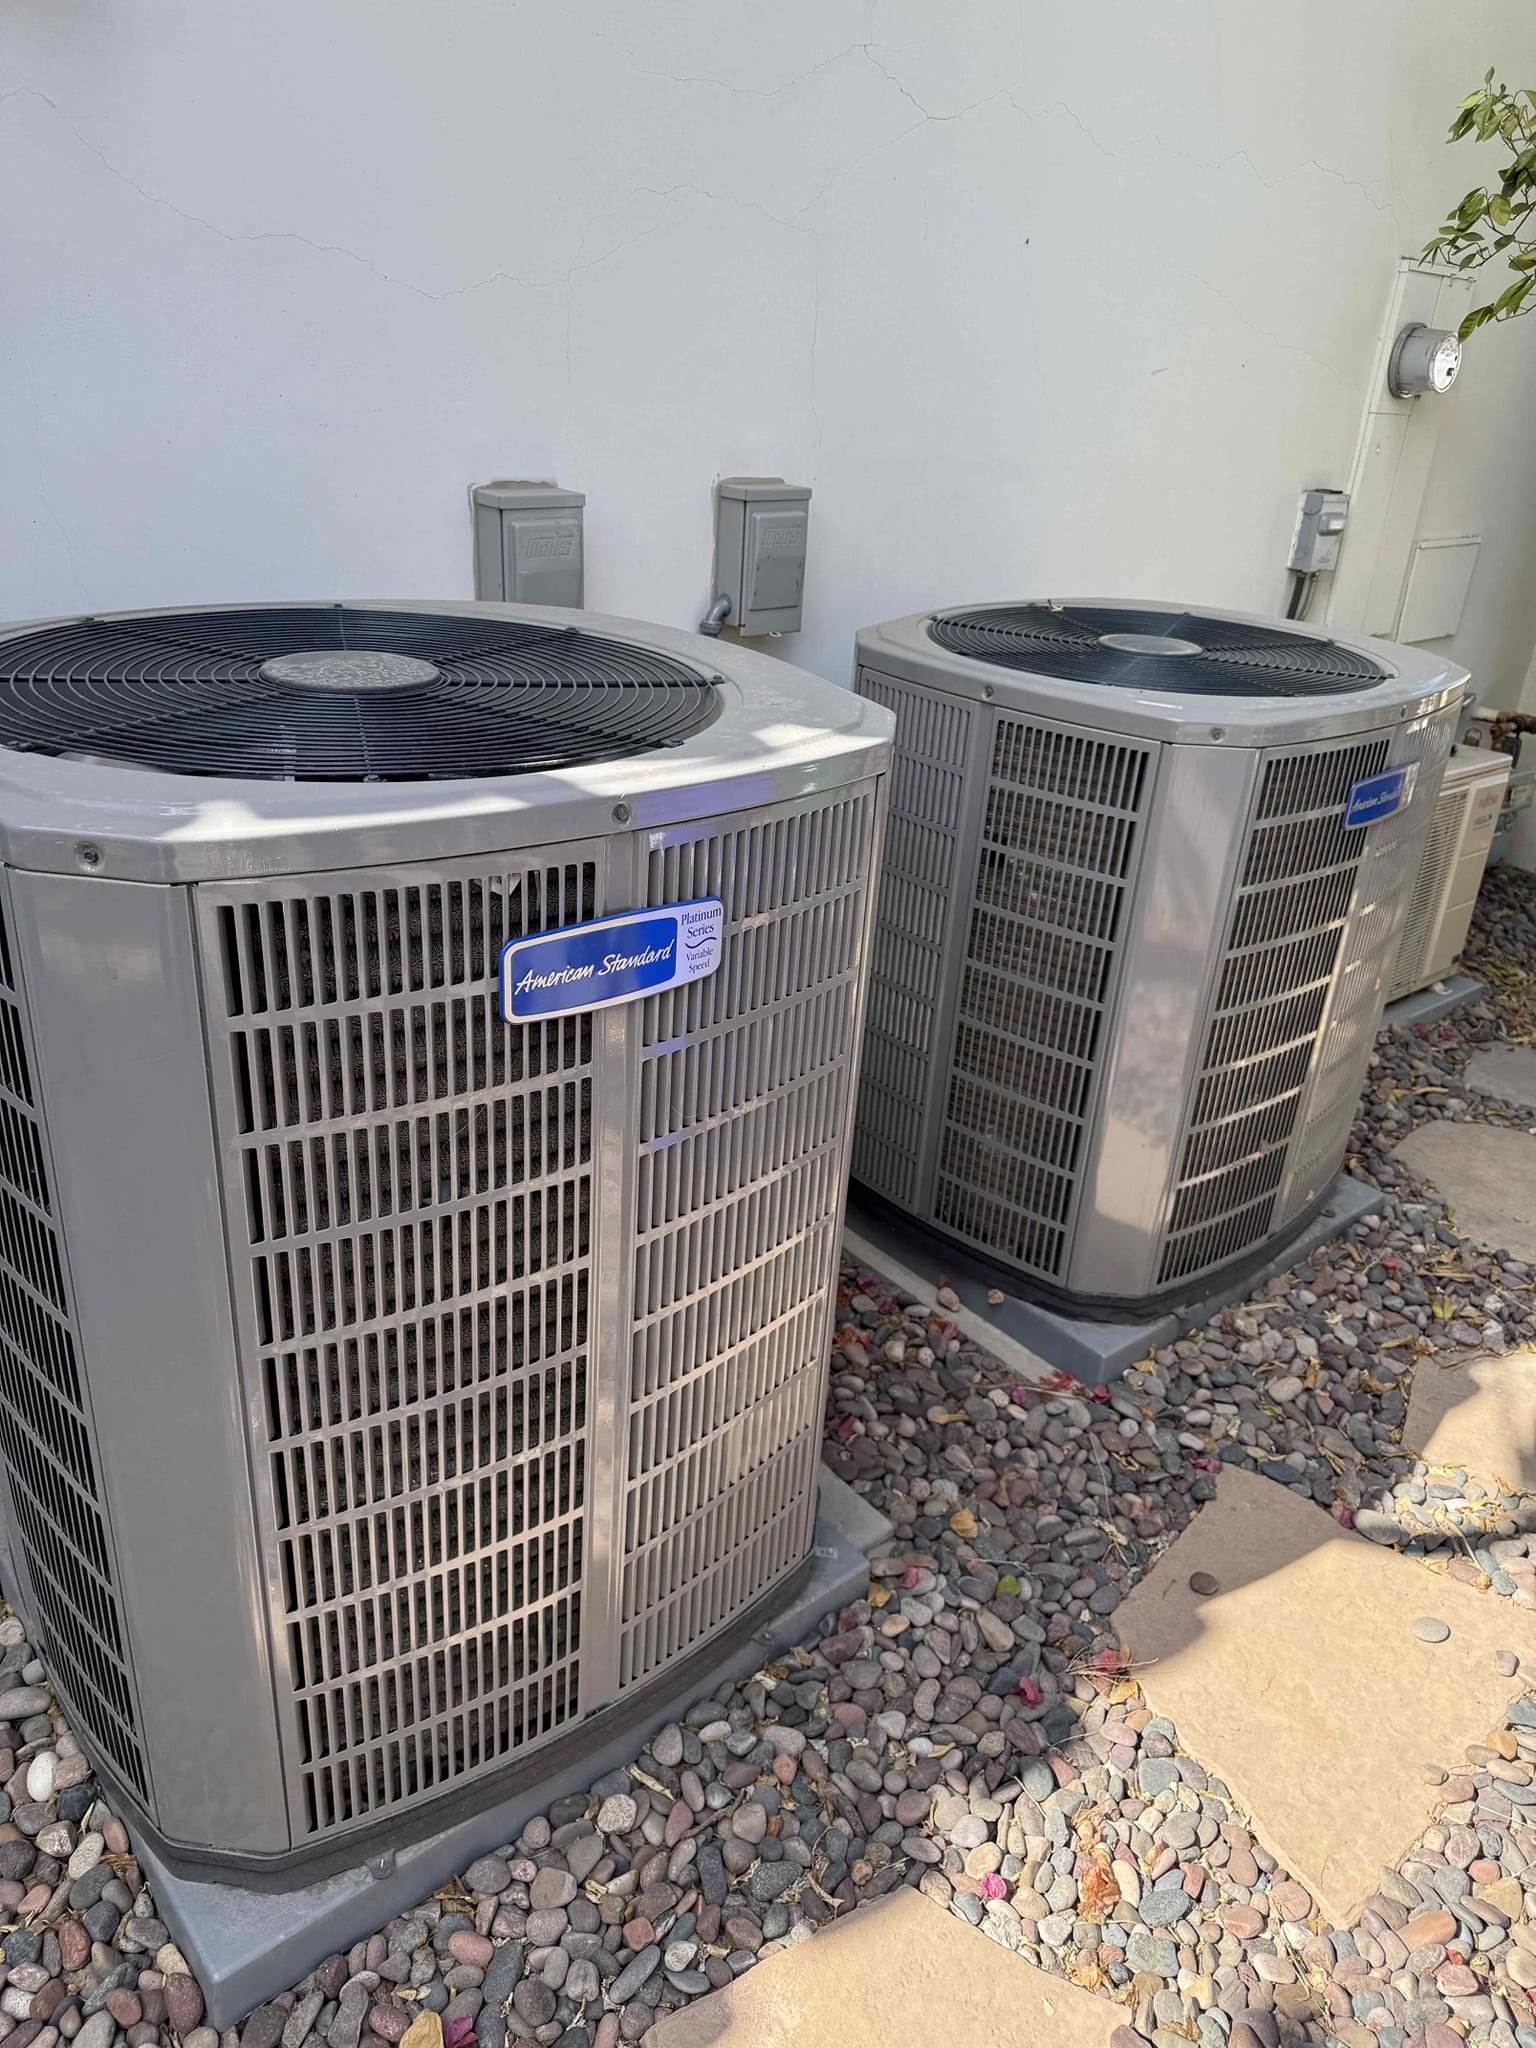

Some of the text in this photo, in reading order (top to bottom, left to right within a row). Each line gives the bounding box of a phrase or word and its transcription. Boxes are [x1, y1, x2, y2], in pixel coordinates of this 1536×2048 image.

[680, 906, 722, 926] Platinum
[687, 921, 715, 939] Series
[685, 946, 714, 962] Variable
[514, 938, 675, 995] American Standard
[688, 958, 711, 974] Speed
